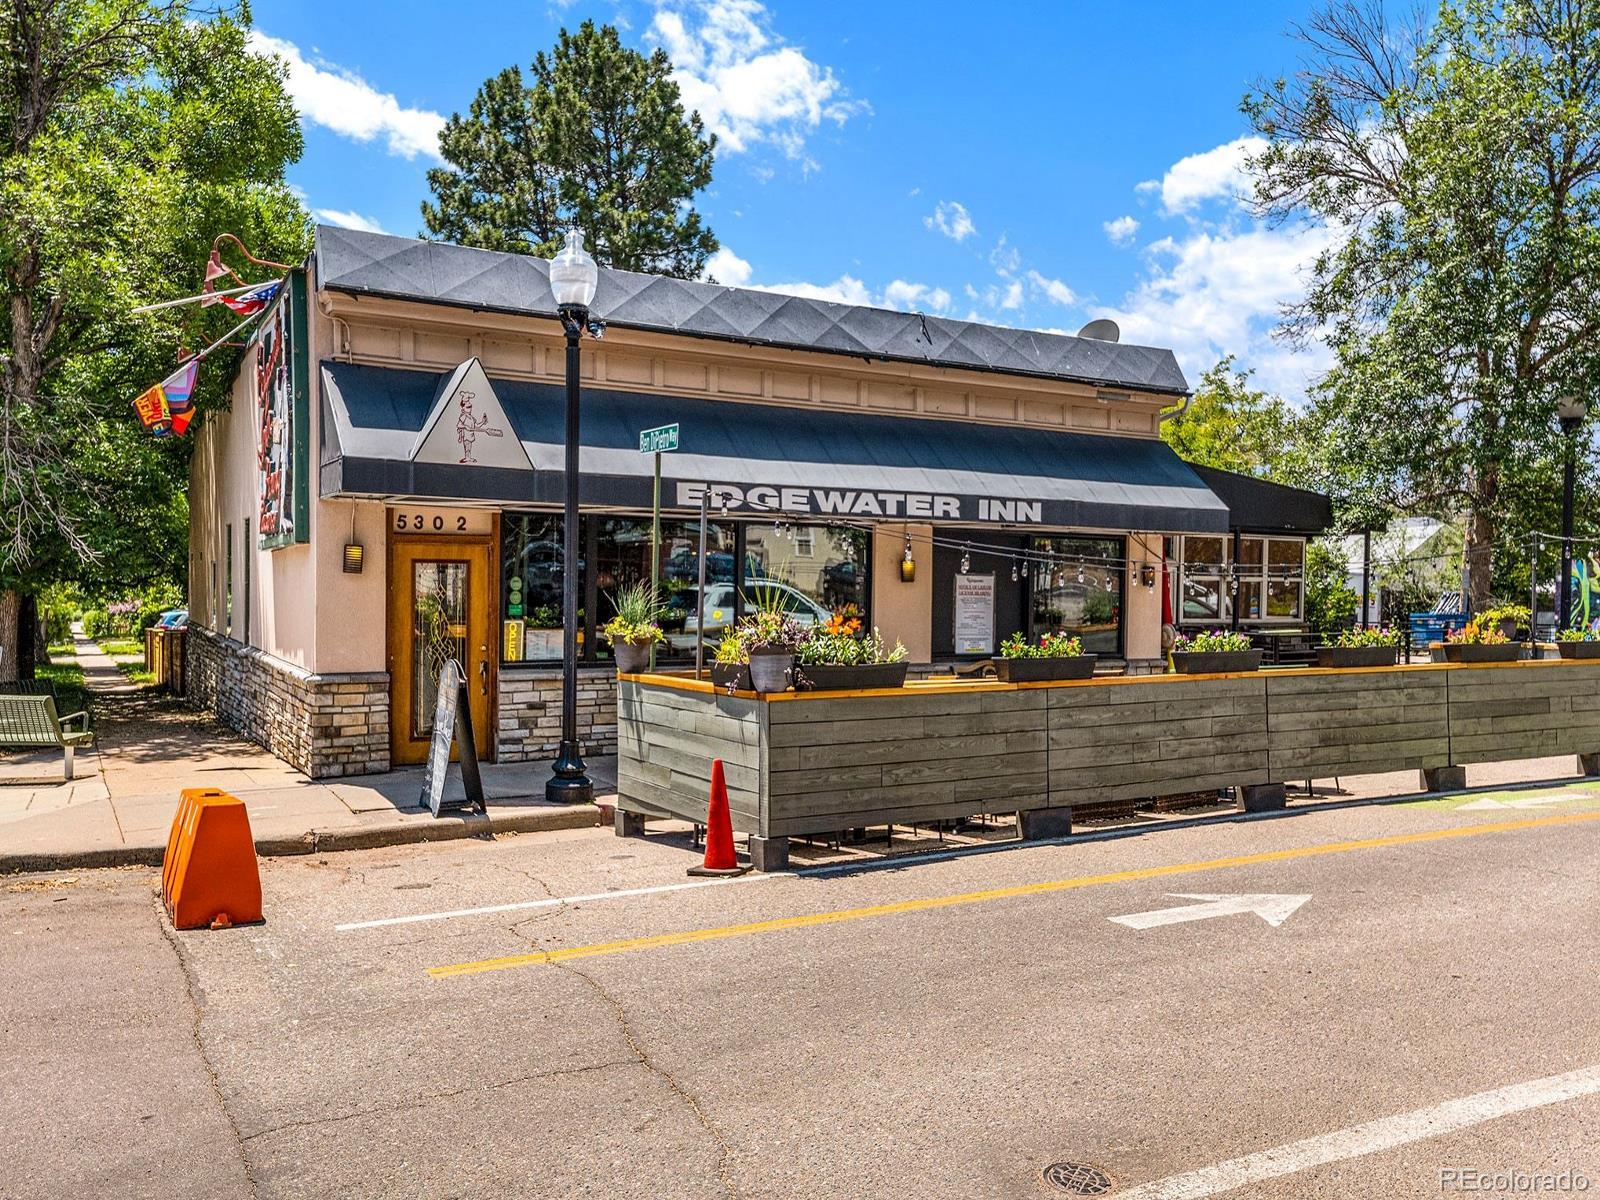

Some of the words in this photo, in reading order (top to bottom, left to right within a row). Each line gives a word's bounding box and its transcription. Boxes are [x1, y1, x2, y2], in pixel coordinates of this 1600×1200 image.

[641, 433, 650, 452] Ben
[676, 482, 961, 520] EDGEWATER
[978, 499, 1042, 523] INN
[507, 622, 518, 661] OPEN
